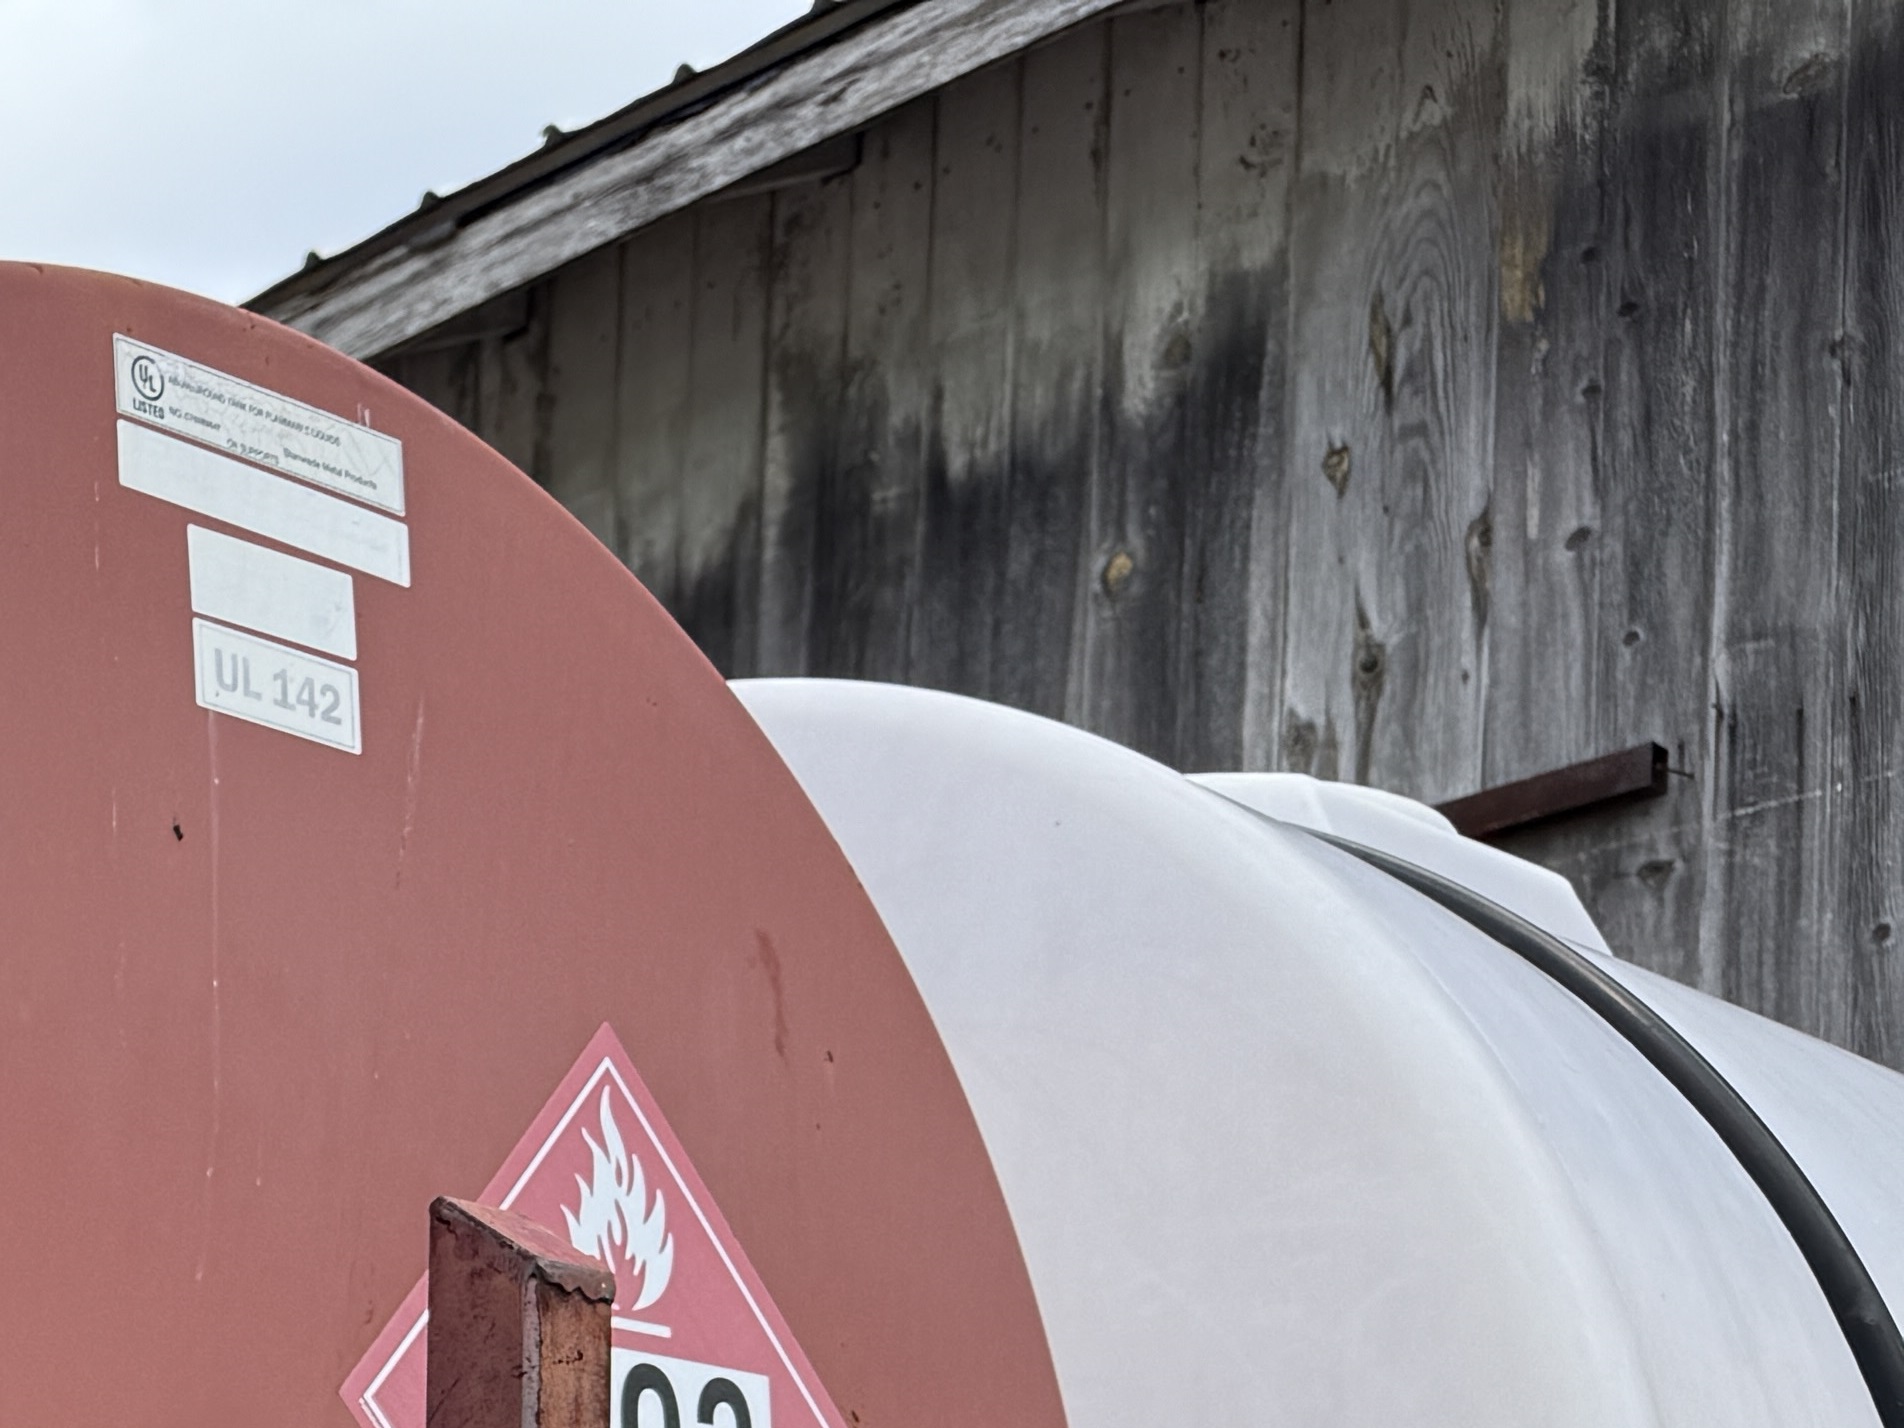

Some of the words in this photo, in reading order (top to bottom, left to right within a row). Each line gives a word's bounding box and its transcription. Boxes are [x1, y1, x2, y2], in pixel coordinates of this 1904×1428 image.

[132, 397, 165, 420] LISTED
[213, 647, 263, 701] UL
[272, 668, 342, 727] 142
